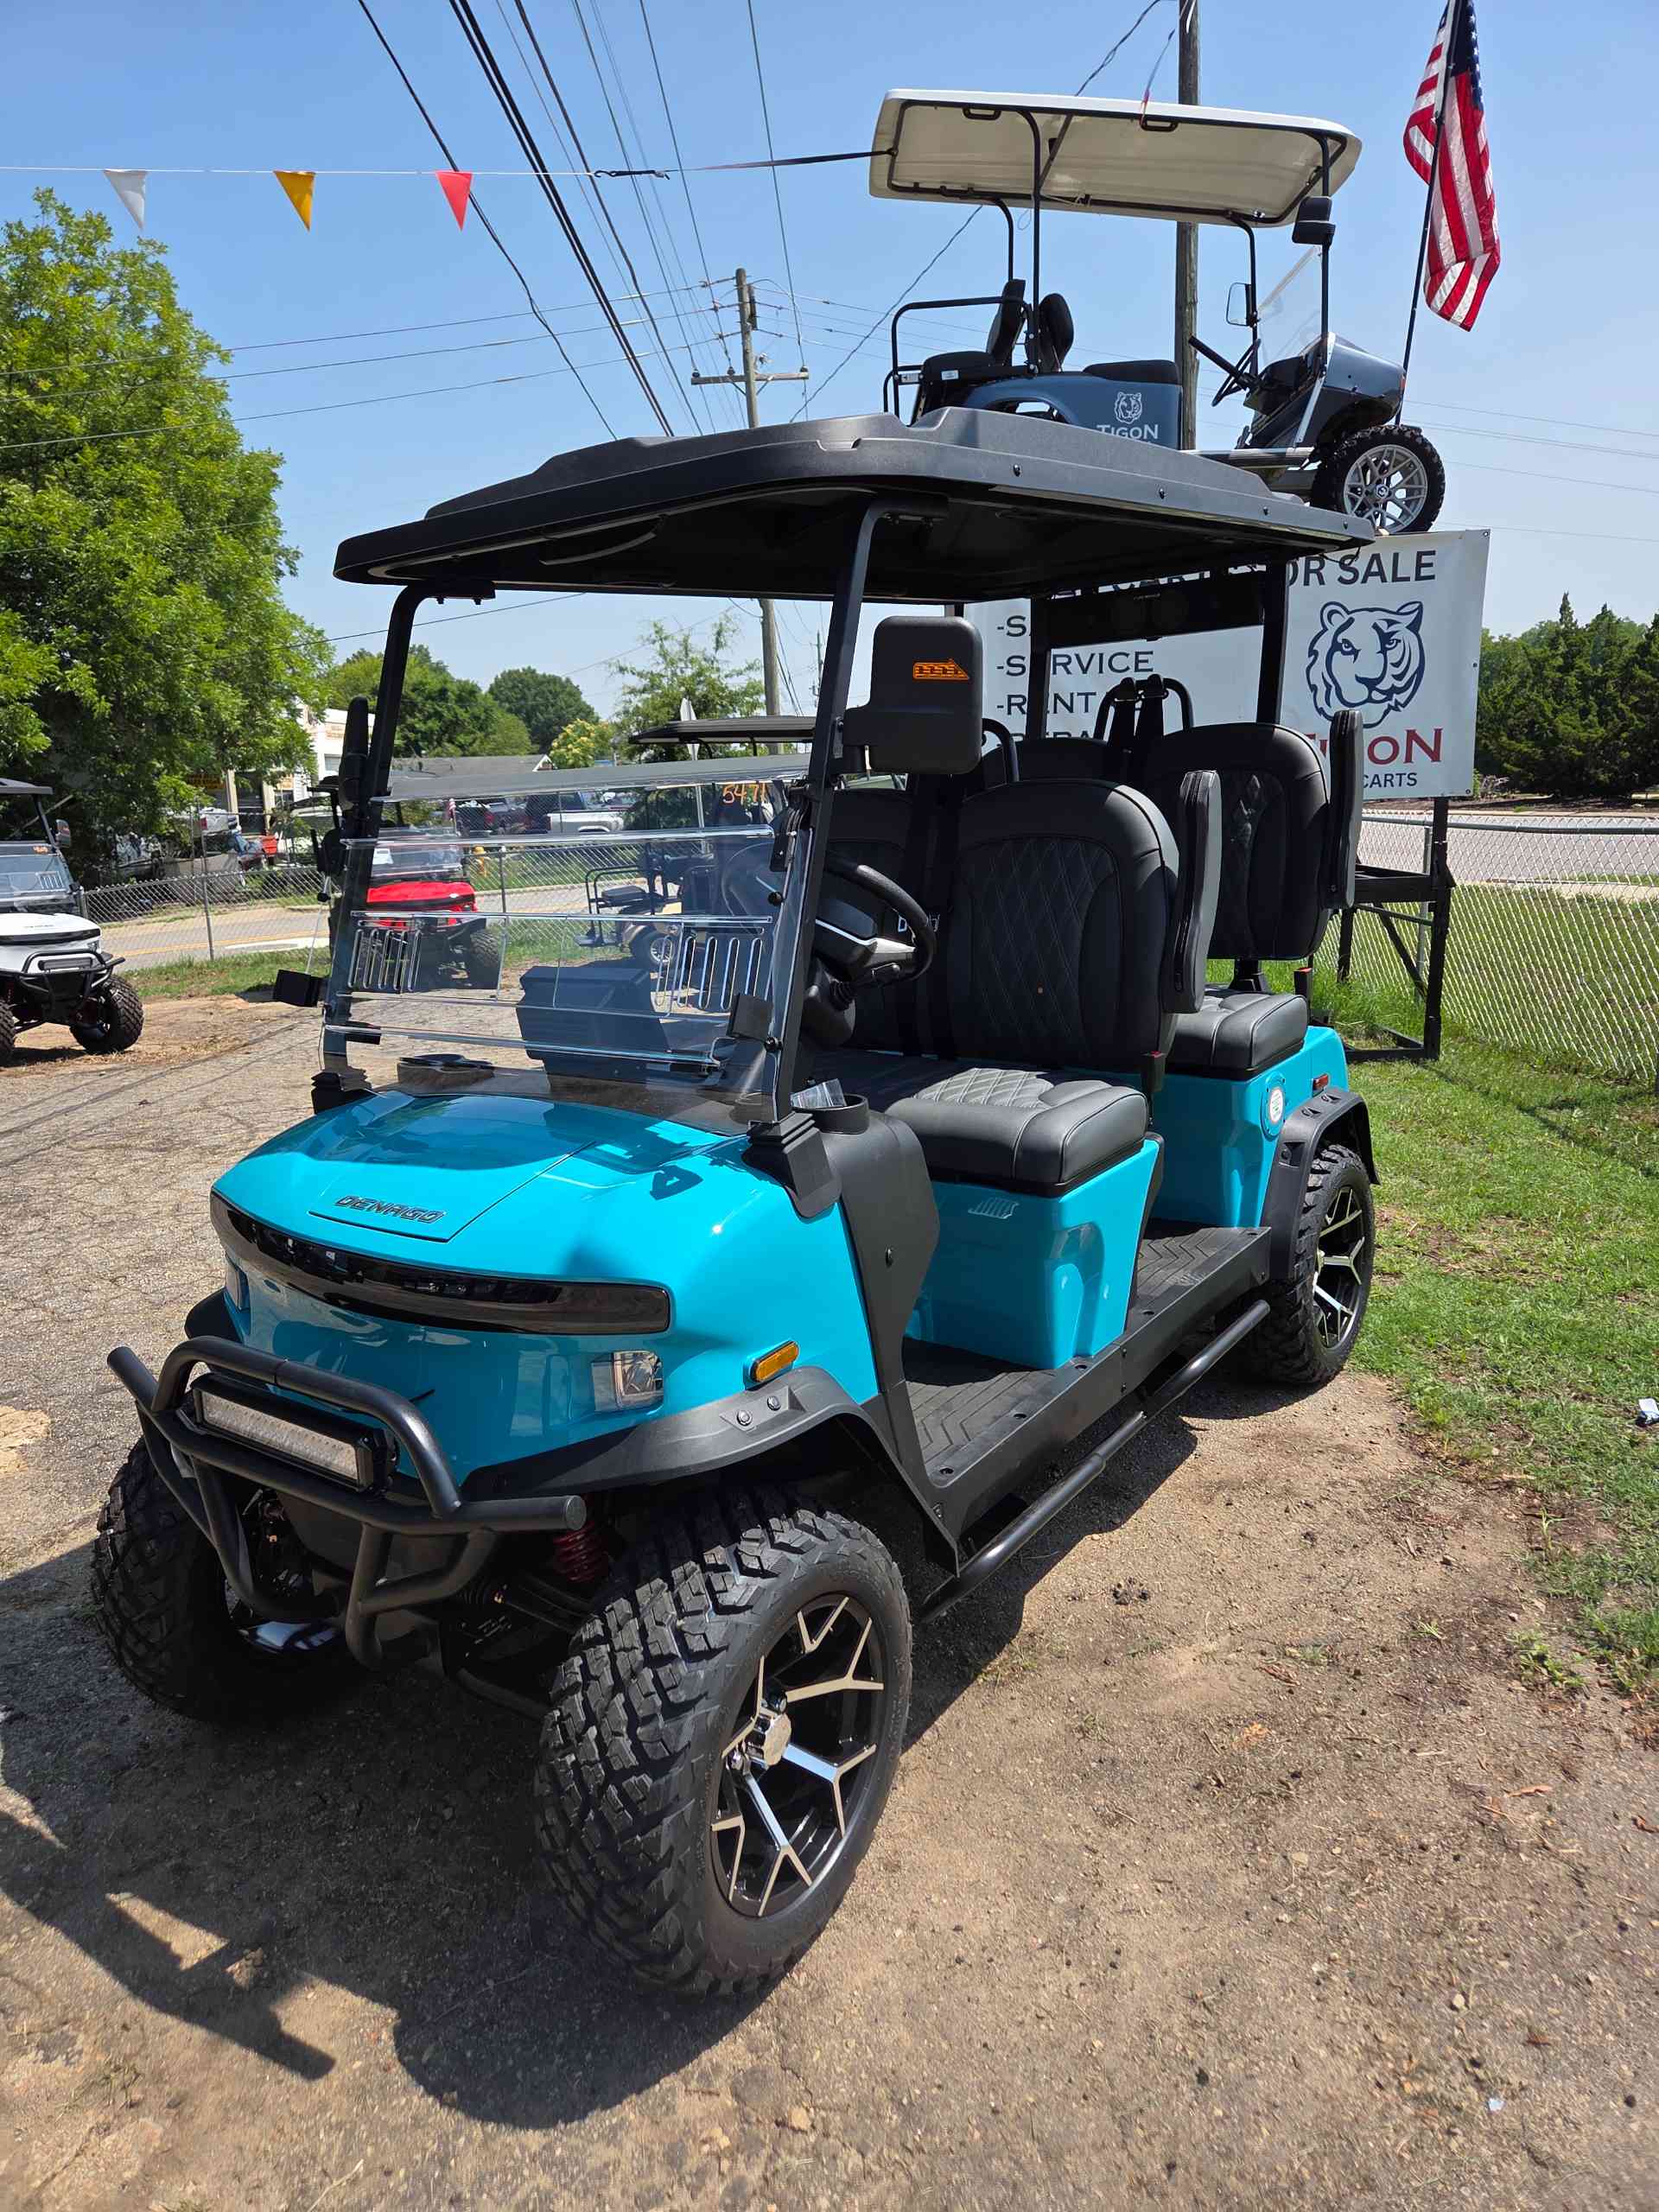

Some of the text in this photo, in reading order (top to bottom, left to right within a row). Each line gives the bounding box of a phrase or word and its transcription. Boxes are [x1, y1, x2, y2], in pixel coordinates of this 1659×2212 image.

[1096, 423, 1159, 439] TIGON
[1337, 550, 1436, 585] SALE
[996, 651, 1154, 677] -SRVICE
[334, 1195, 448, 1224] DENAGO
